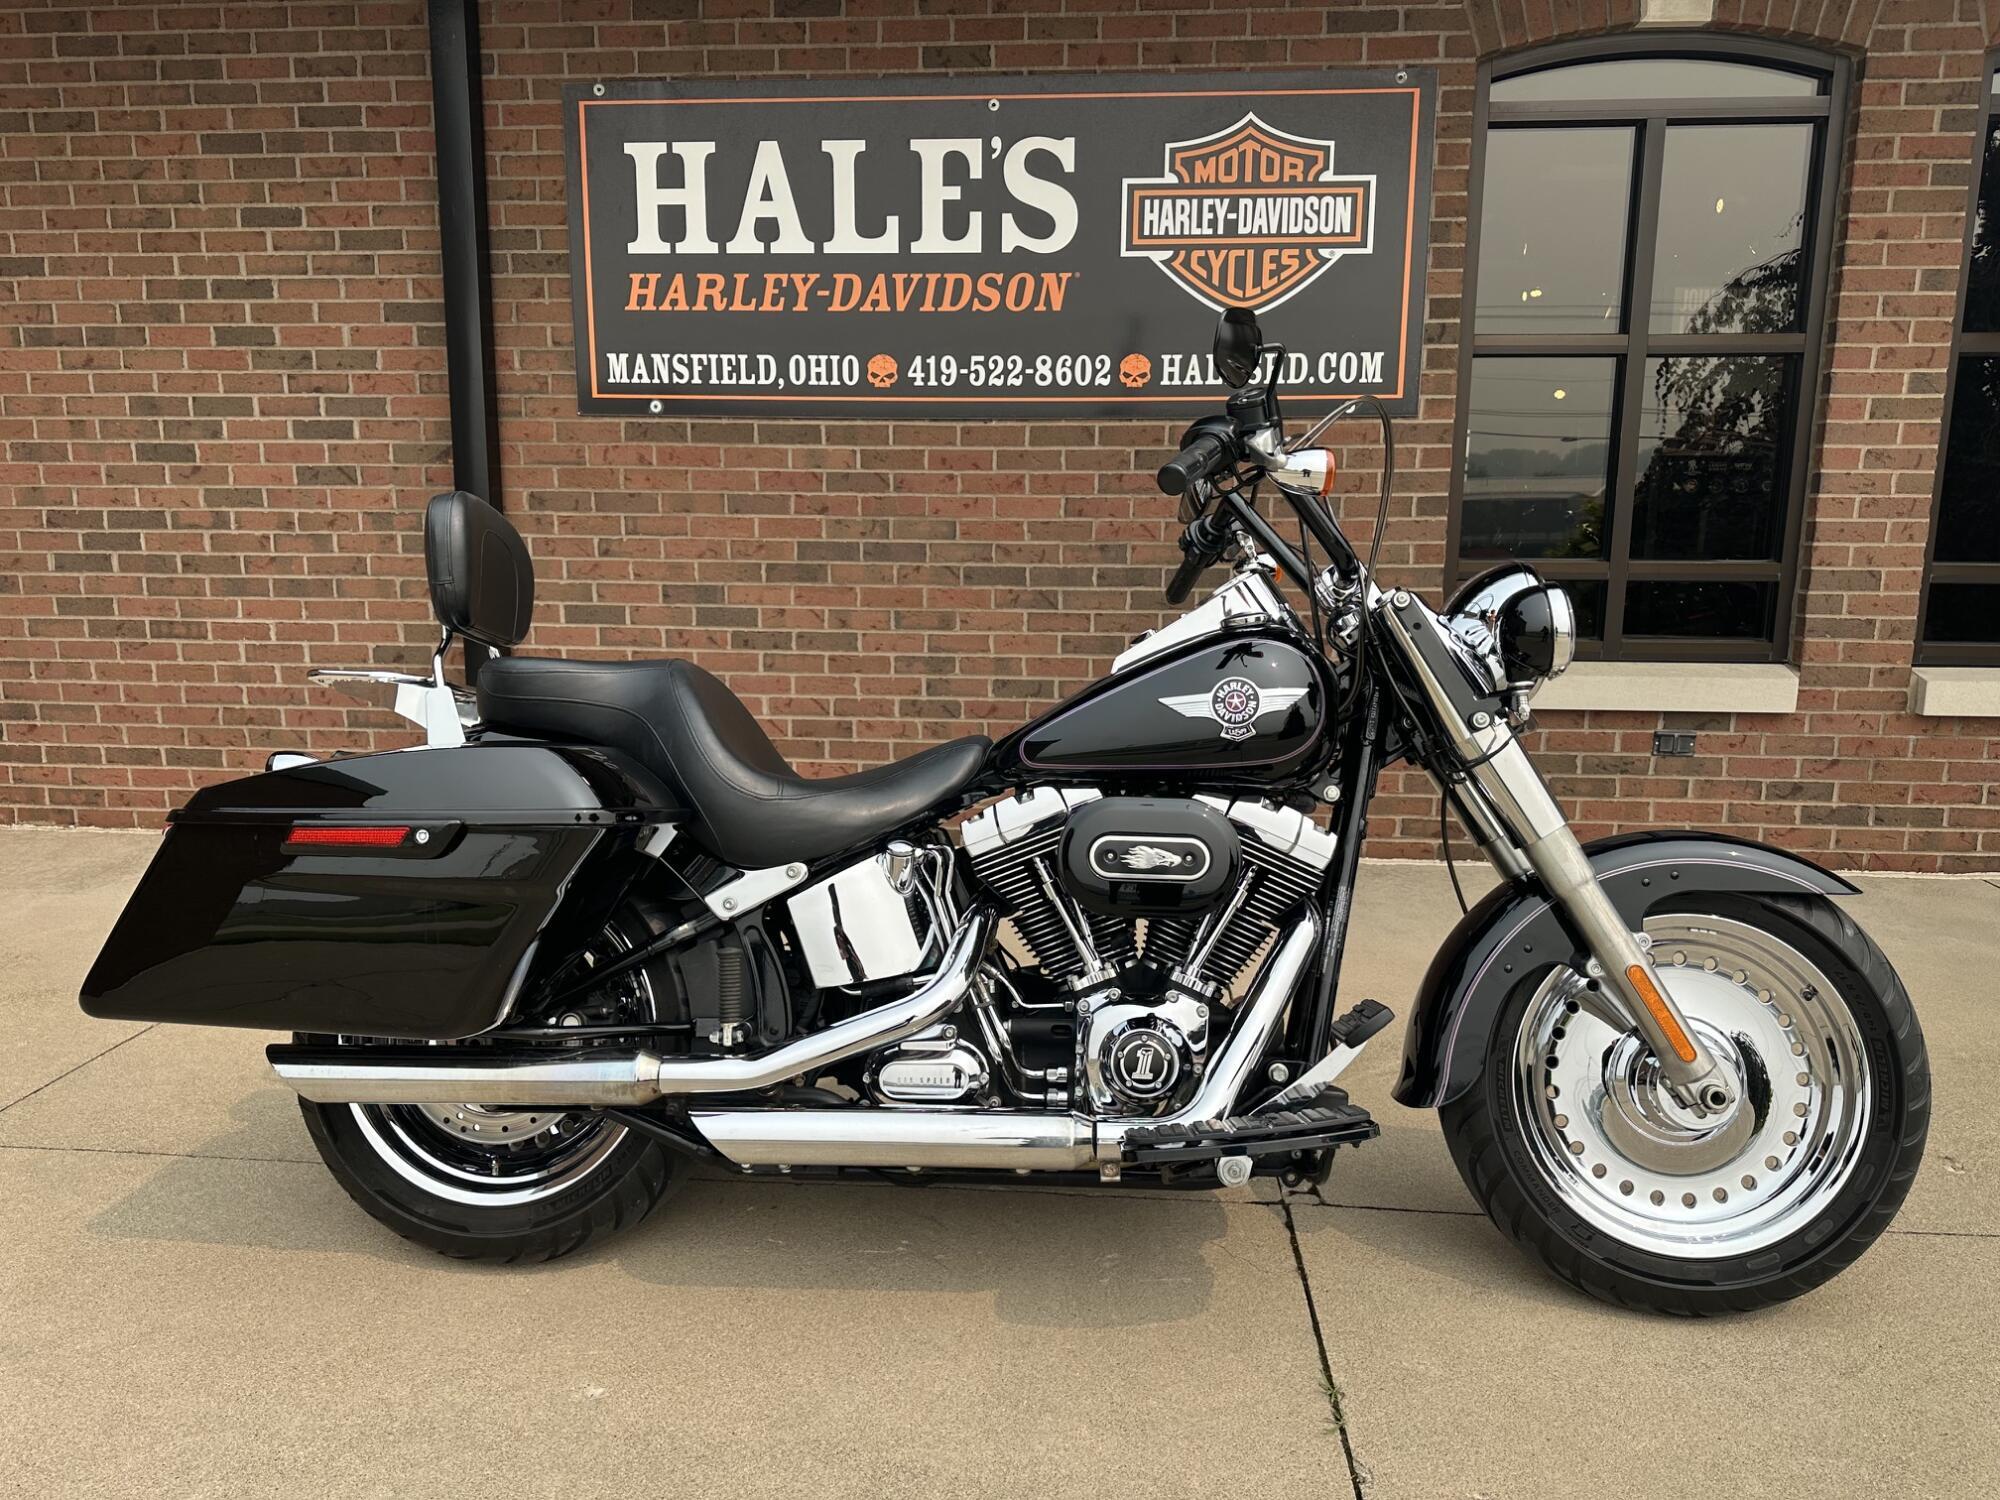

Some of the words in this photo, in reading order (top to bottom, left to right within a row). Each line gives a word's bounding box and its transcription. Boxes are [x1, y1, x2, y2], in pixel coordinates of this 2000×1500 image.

[1194, 139, 1305, 183] MOTOR
[623, 136, 1079, 254] HALE'S
[1143, 195, 1352, 236] HARLEY-DAVIDSON
[624, 272, 1072, 312] HARLEY-DAVIDSON
[1190, 248, 1300, 298] CYCLES
[907, 354, 1111, 387] 419-522-8602
[1216, 682, 1254, 698] HARLEY
[1215, 701, 1257, 722] DAVIDSON
[1497, 1061, 1511, 1129] MICHELIN
